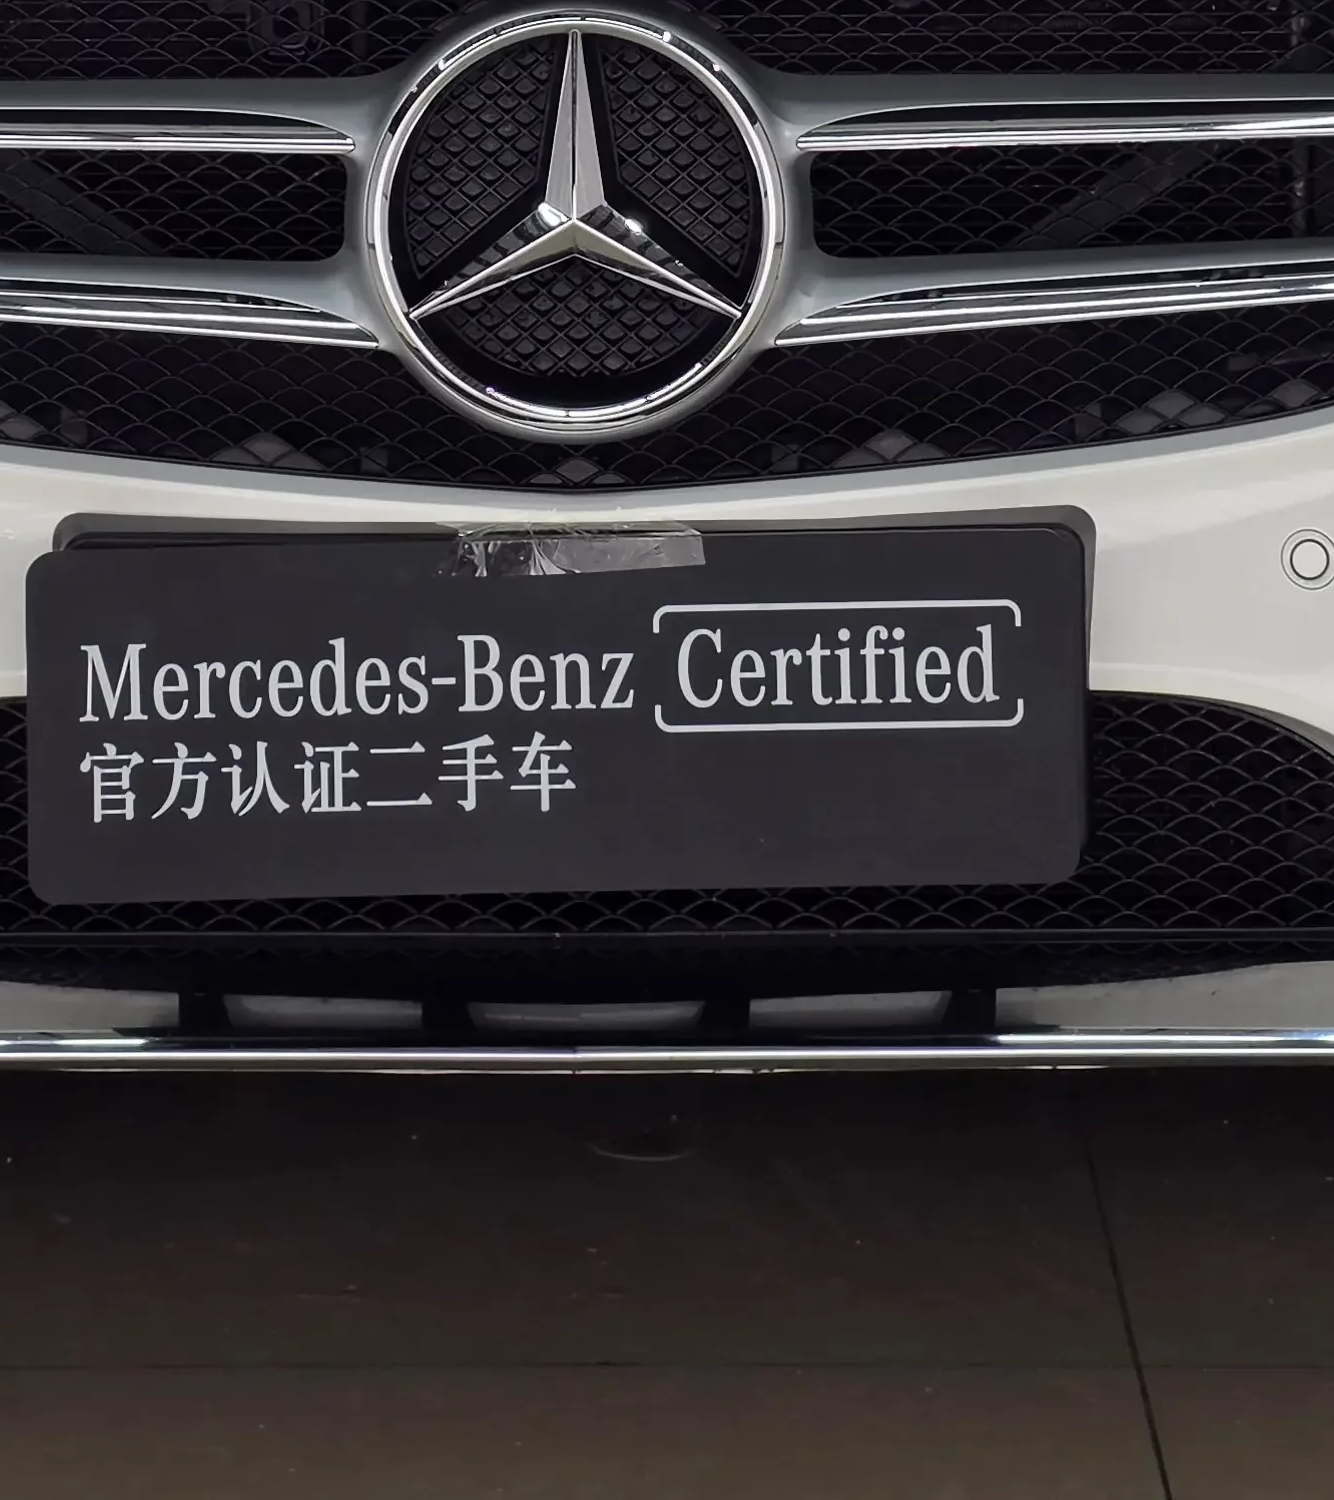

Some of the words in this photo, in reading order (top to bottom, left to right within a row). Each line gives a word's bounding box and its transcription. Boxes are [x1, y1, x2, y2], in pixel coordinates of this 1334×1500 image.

[79, 634, 635, 723] Mercedes-Benz
[677, 623, 1000, 709] Certified
[79, 730, 577, 823] 官方认证二手车
